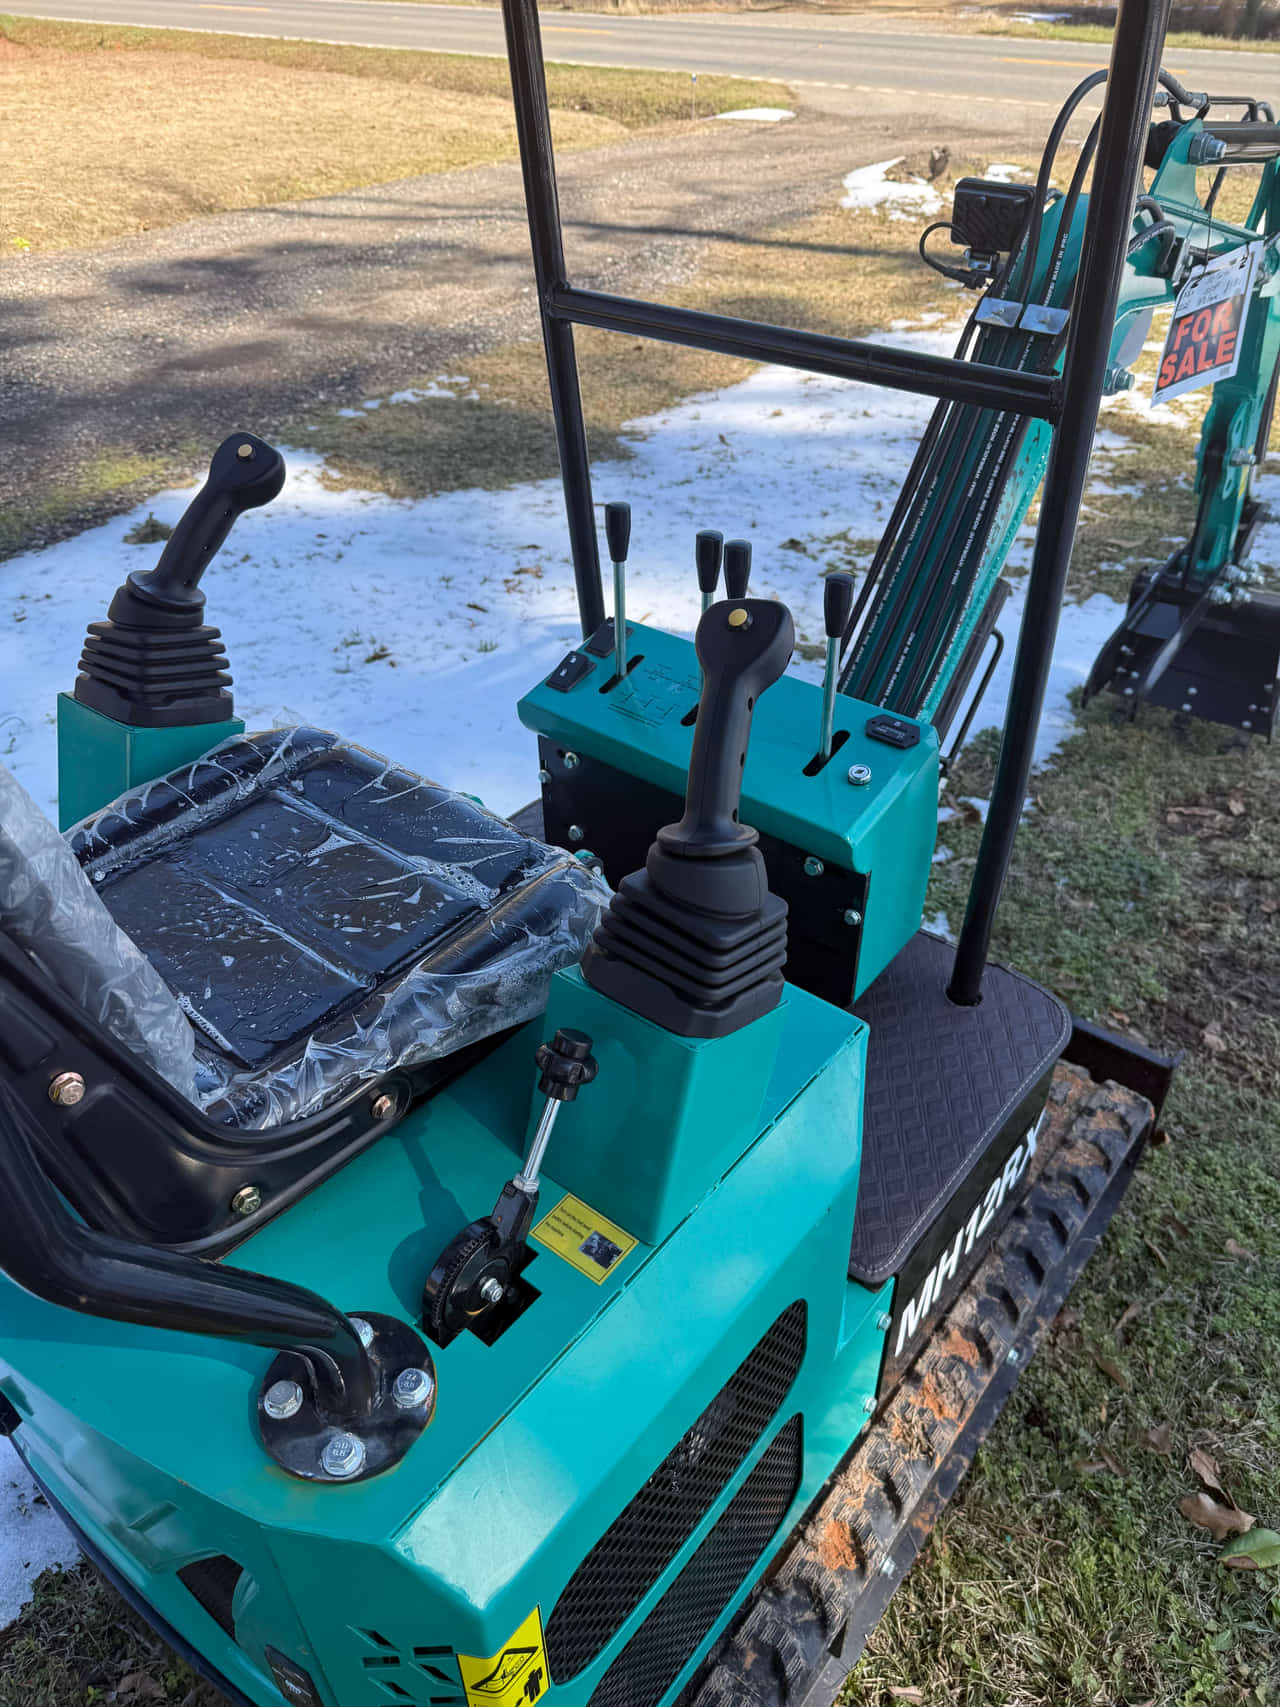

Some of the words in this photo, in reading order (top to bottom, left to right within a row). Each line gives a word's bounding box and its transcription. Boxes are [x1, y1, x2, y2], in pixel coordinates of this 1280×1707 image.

[1173, 302, 1233, 351] FOR
[1158, 331, 1237, 388] SALE
[895, 1106, 1046, 1357] MH12RX
